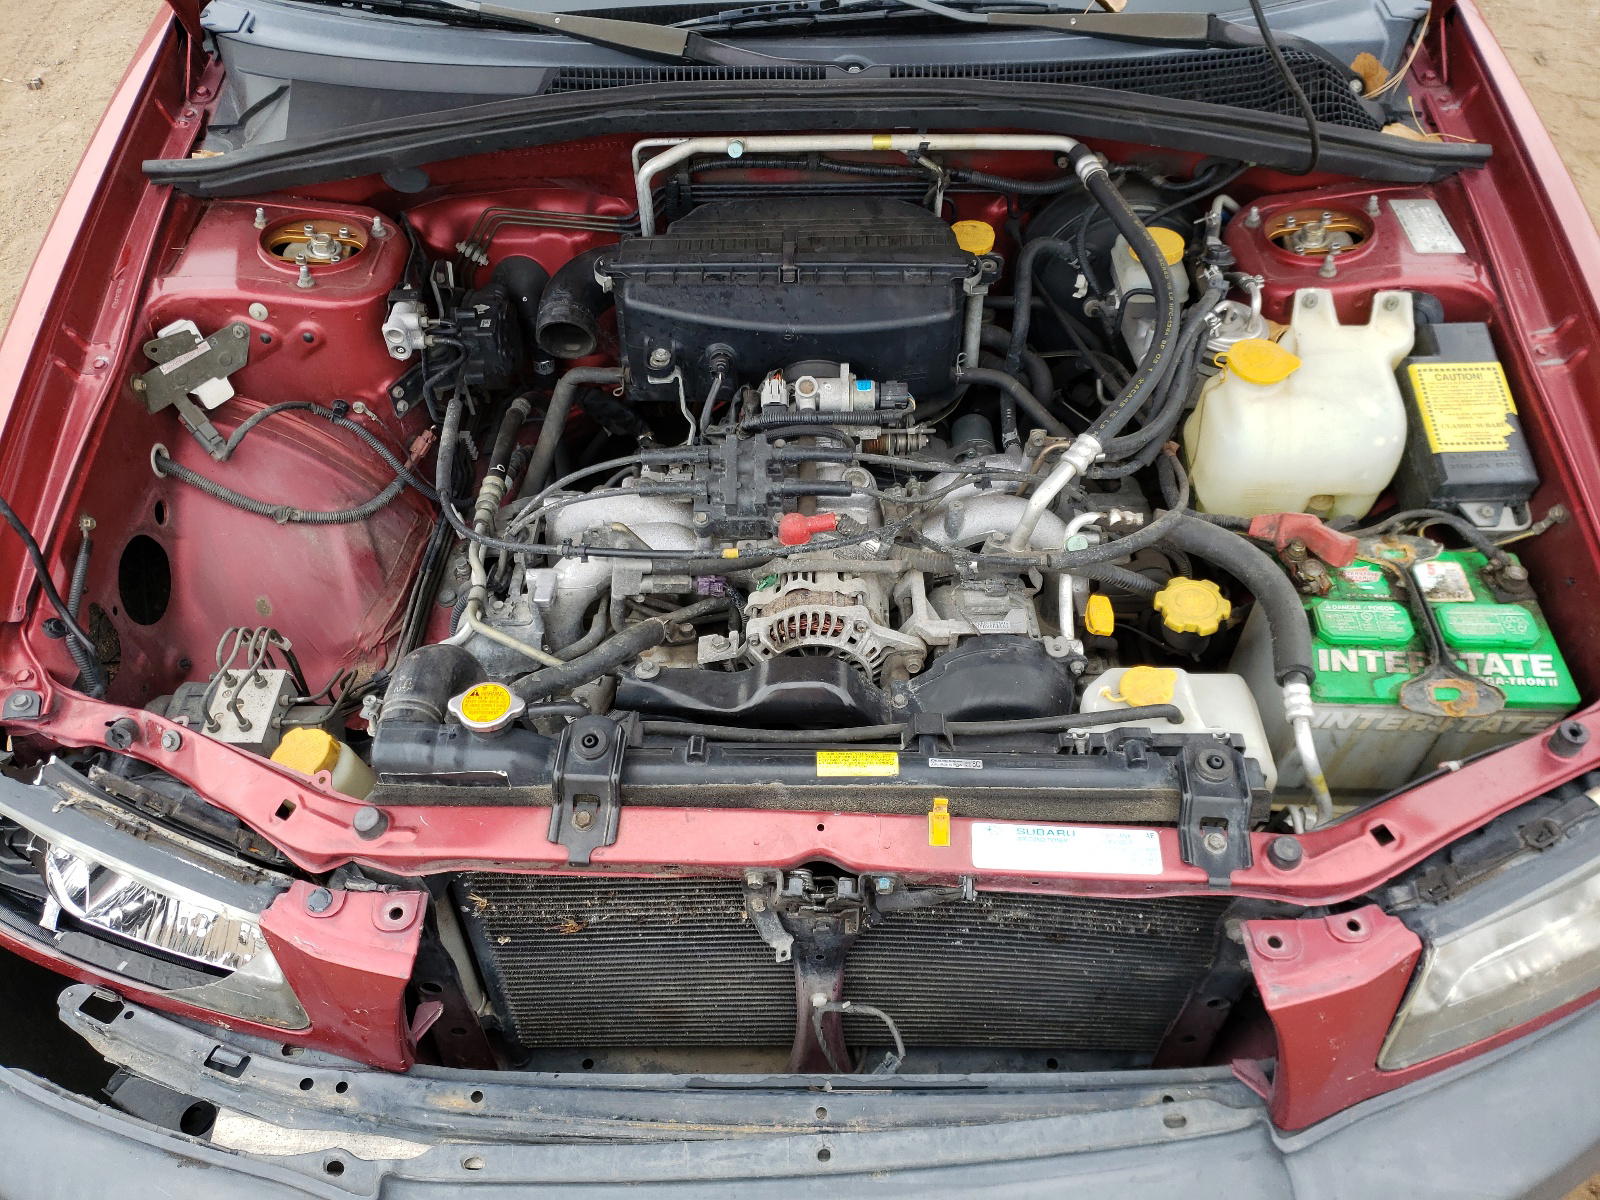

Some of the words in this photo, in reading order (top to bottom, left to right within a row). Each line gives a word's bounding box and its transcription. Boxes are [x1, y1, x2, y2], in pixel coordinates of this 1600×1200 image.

[1434, 373, 1483, 381] CAUTION!
[1318, 649, 1557, 677] INTERTATE
[1016, 828, 1076, 837] SUBARU
